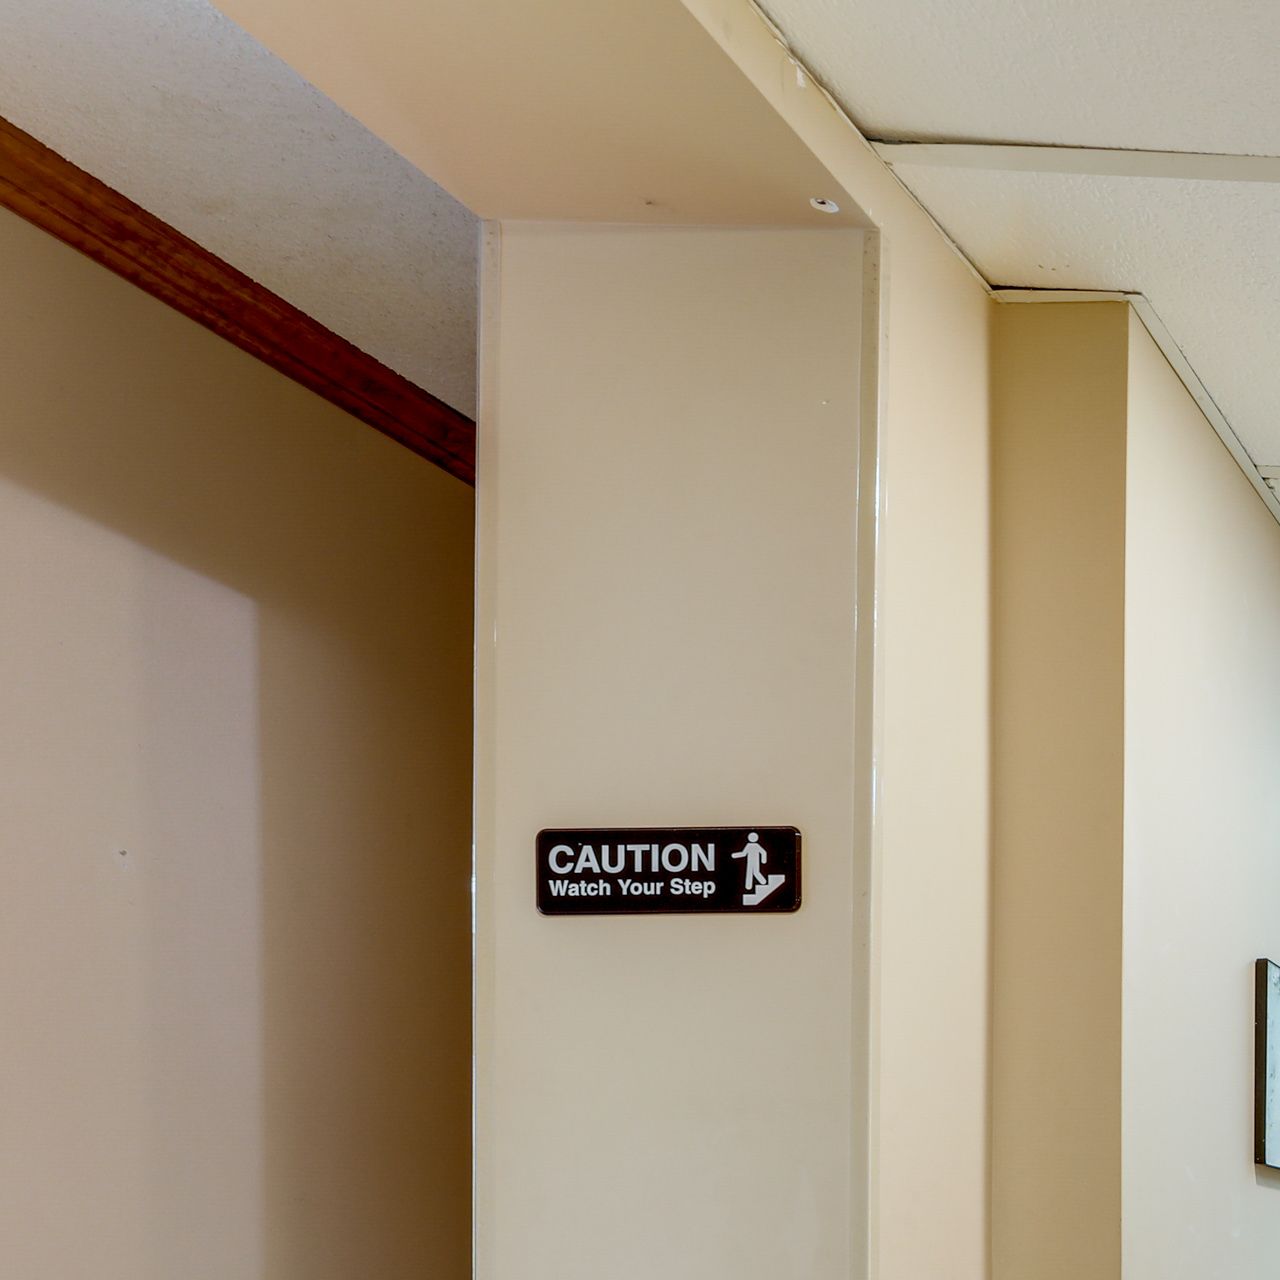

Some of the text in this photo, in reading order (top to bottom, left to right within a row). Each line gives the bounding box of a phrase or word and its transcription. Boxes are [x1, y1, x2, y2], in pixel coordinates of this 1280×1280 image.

[548, 843, 716, 874] CAUTION
[548, 878, 716, 898] Watch Your Step
